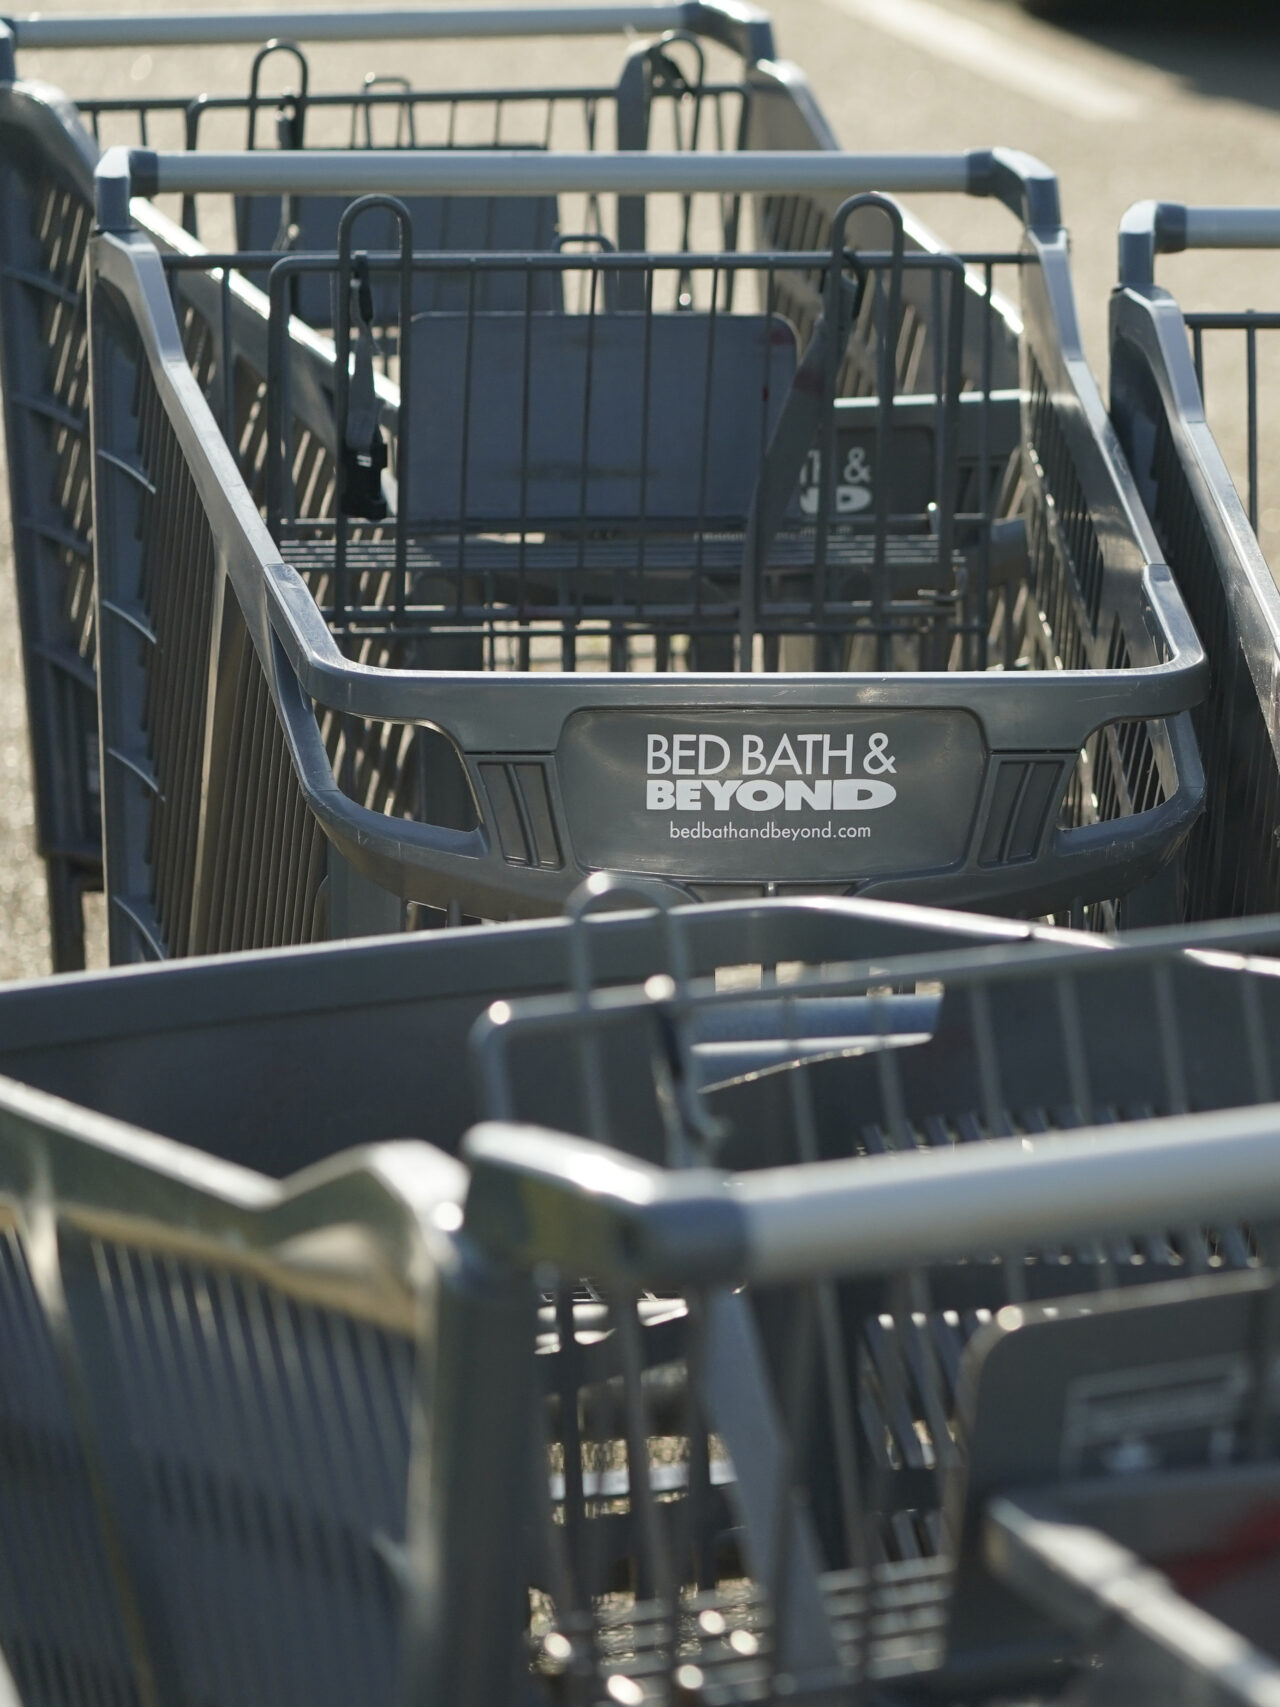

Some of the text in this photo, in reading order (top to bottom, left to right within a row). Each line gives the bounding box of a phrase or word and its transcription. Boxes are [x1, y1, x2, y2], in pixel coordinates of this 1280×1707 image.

[646, 732, 897, 775] BED BATH &
[646, 778, 897, 811] BEYOND
[669, 821, 872, 841] bedbathandbeyond.com
